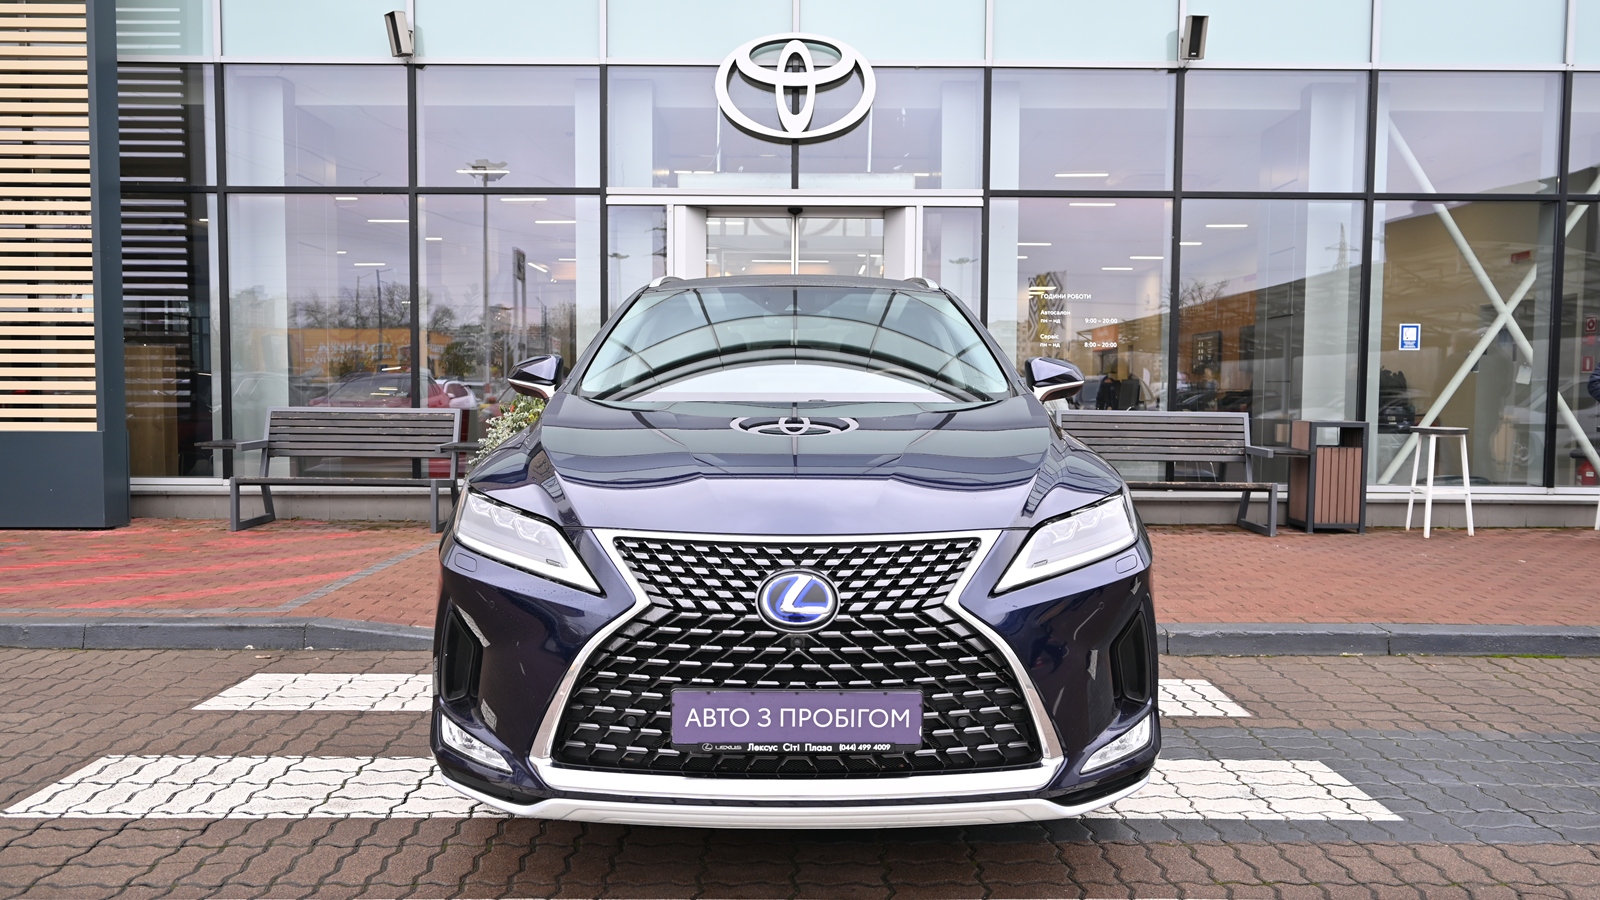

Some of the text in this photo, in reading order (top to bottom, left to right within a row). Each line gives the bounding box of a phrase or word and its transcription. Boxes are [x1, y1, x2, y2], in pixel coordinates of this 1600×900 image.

[684, 707, 751, 729] АВТО
[780, 707, 911, 729] ПРОБІГОМ
[746, 742, 779, 753] Лексус
[782, 742, 800, 752] Сіті
[804, 742, 833, 752] Плаза
[839, 743, 857, 752] (044)
[857, 743, 872, 751] 499
[873, 743, 891, 751] 4009
